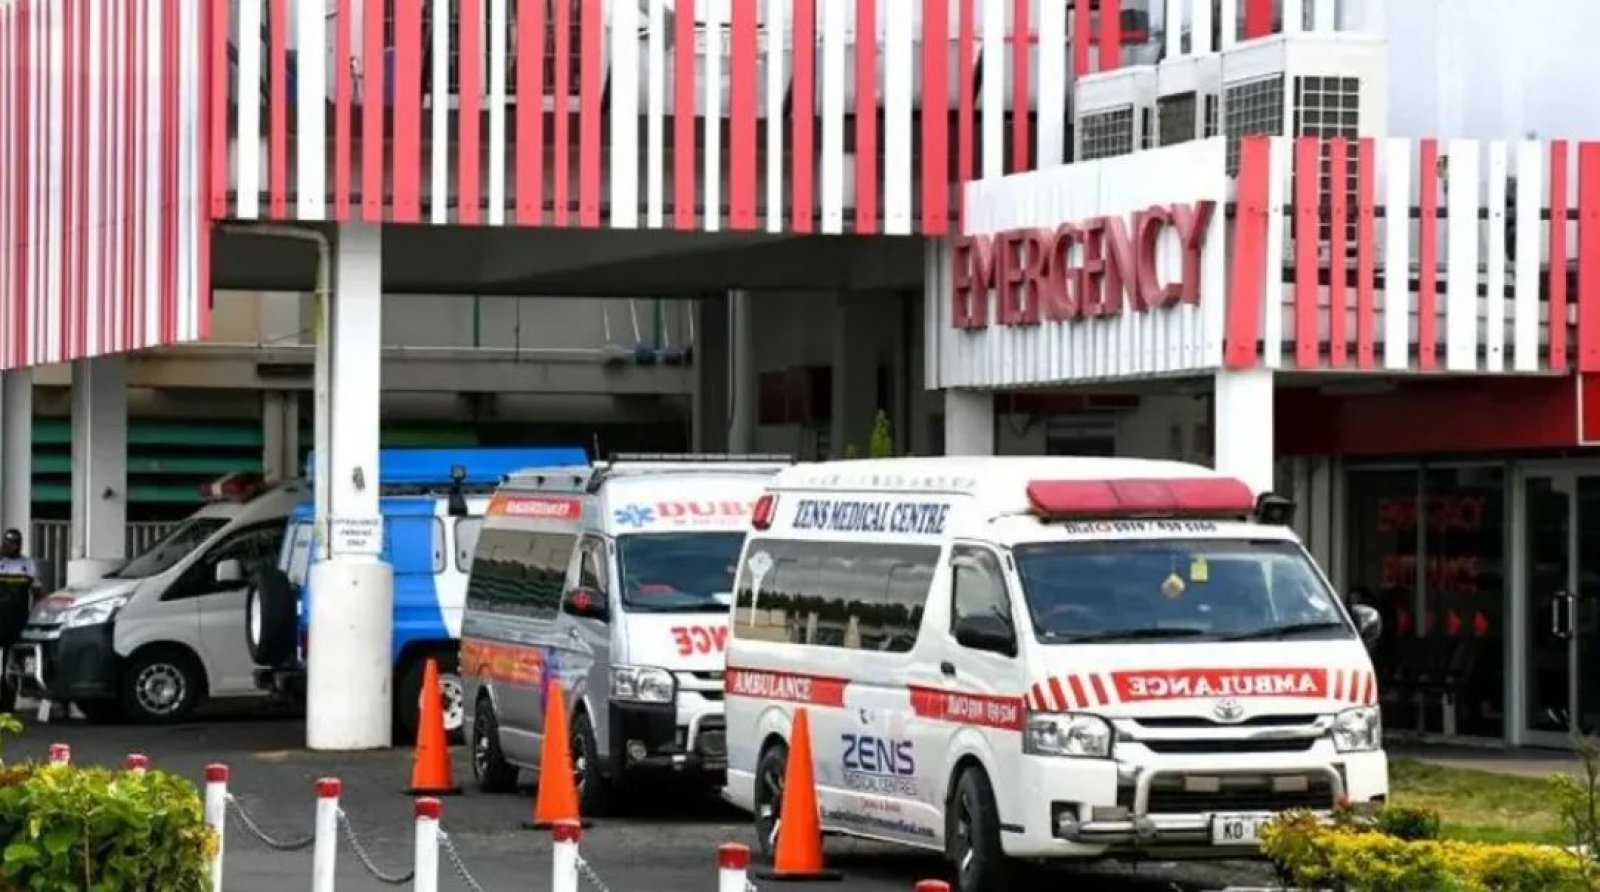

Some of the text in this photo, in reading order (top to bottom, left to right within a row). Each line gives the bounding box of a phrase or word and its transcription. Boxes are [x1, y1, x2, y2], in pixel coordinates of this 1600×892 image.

[952, 200, 1216, 331] EMERGENCY
[792, 499, 951, 534] ZENS MEDICAL CENTRE
[732, 670, 812, 700] AMBULANCE
[841, 733, 915, 775] ZENS
